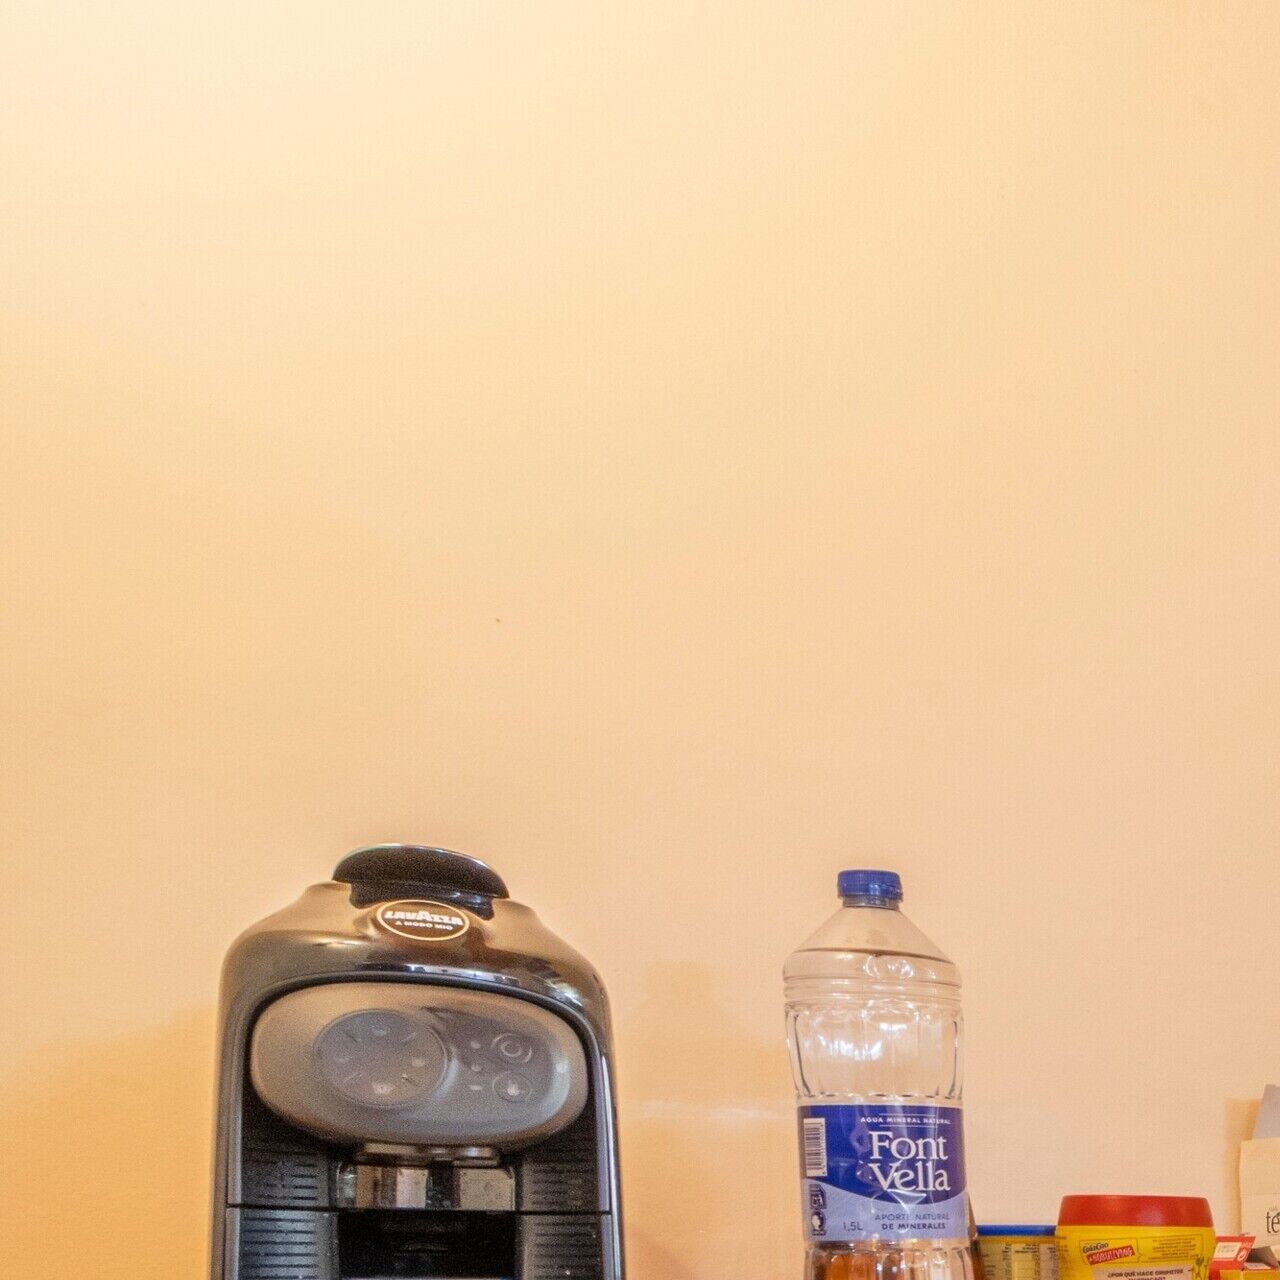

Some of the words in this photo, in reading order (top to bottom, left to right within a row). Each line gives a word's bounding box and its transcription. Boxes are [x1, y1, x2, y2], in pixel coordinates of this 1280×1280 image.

[384, 910, 464, 926] LAVAZZA
[434, 923, 454, 931] MIO
[886, 1116, 921, 1124] MINERAL
[868, 1131, 949, 1160] Font
[868, 1161, 952, 1191] Vella
[915, 1213, 950, 1221] NATURAL
[897, 1222, 946, 1230] MINERALES
